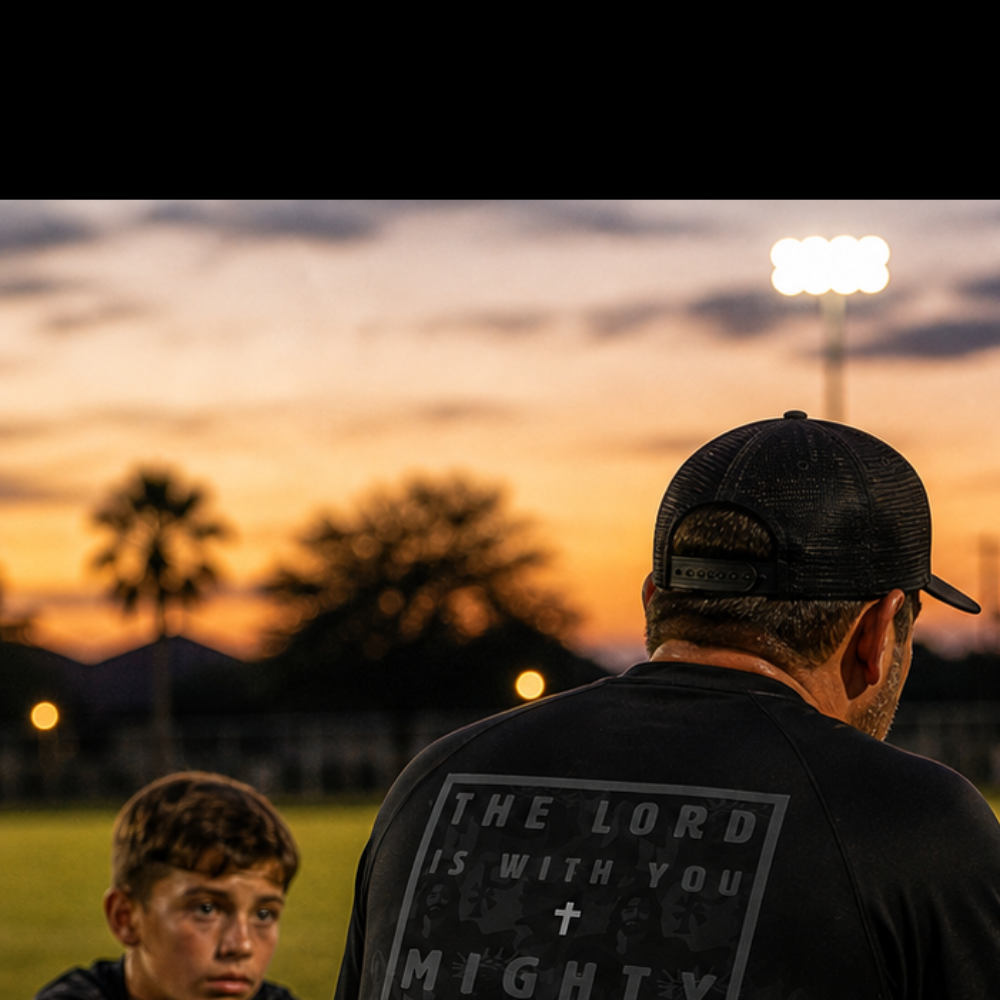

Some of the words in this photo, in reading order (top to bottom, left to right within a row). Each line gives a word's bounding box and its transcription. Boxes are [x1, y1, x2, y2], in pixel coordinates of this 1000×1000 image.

[450, 792, 554, 829] THE
[591, 800, 757, 843] LORD
[429, 849, 469, 876] IS
[499, 853, 613, 886] WITH
[648, 862, 743, 897] YOU
